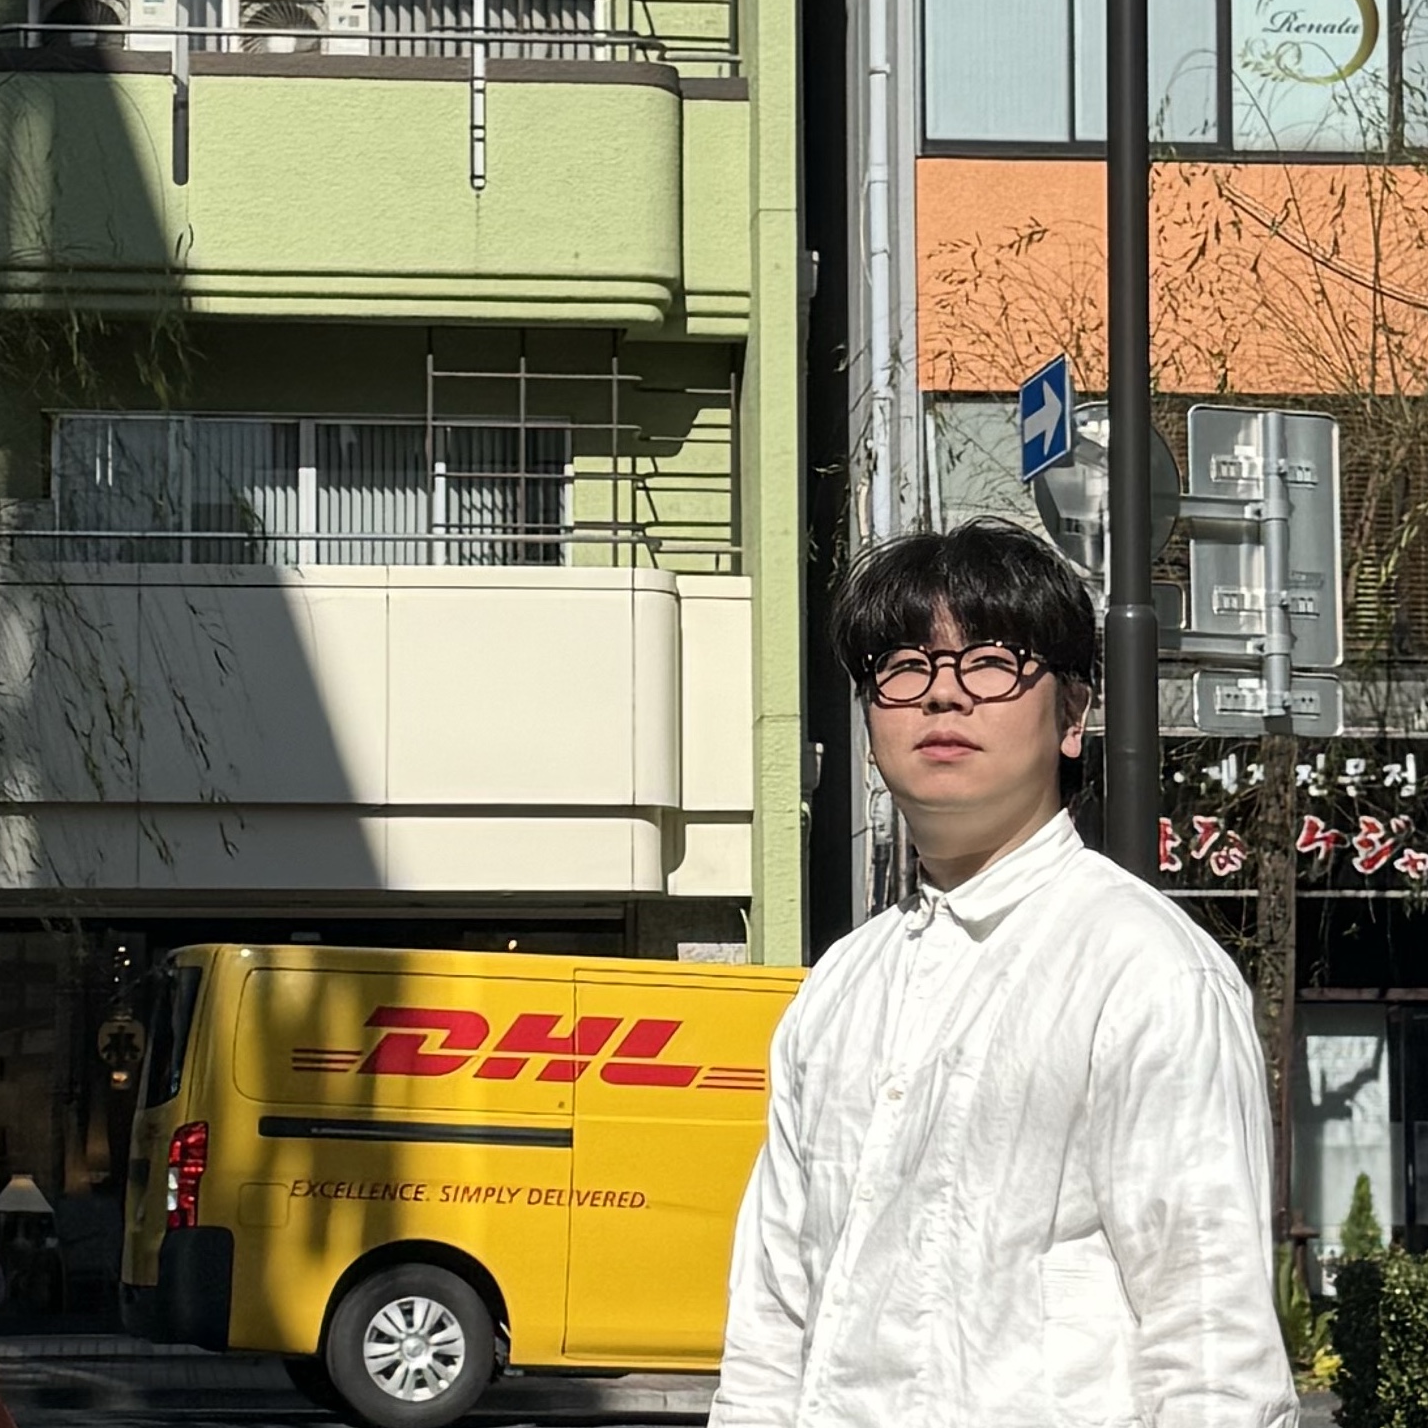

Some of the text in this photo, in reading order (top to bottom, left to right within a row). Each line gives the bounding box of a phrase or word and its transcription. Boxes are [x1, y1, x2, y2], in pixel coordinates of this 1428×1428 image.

[1262, 9, 1360, 35] Renata
[356, 1006, 703, 1088] DHL
[290, 1179, 651, 1210] EXCELLENCE. SIMPLY DELIVERED.
